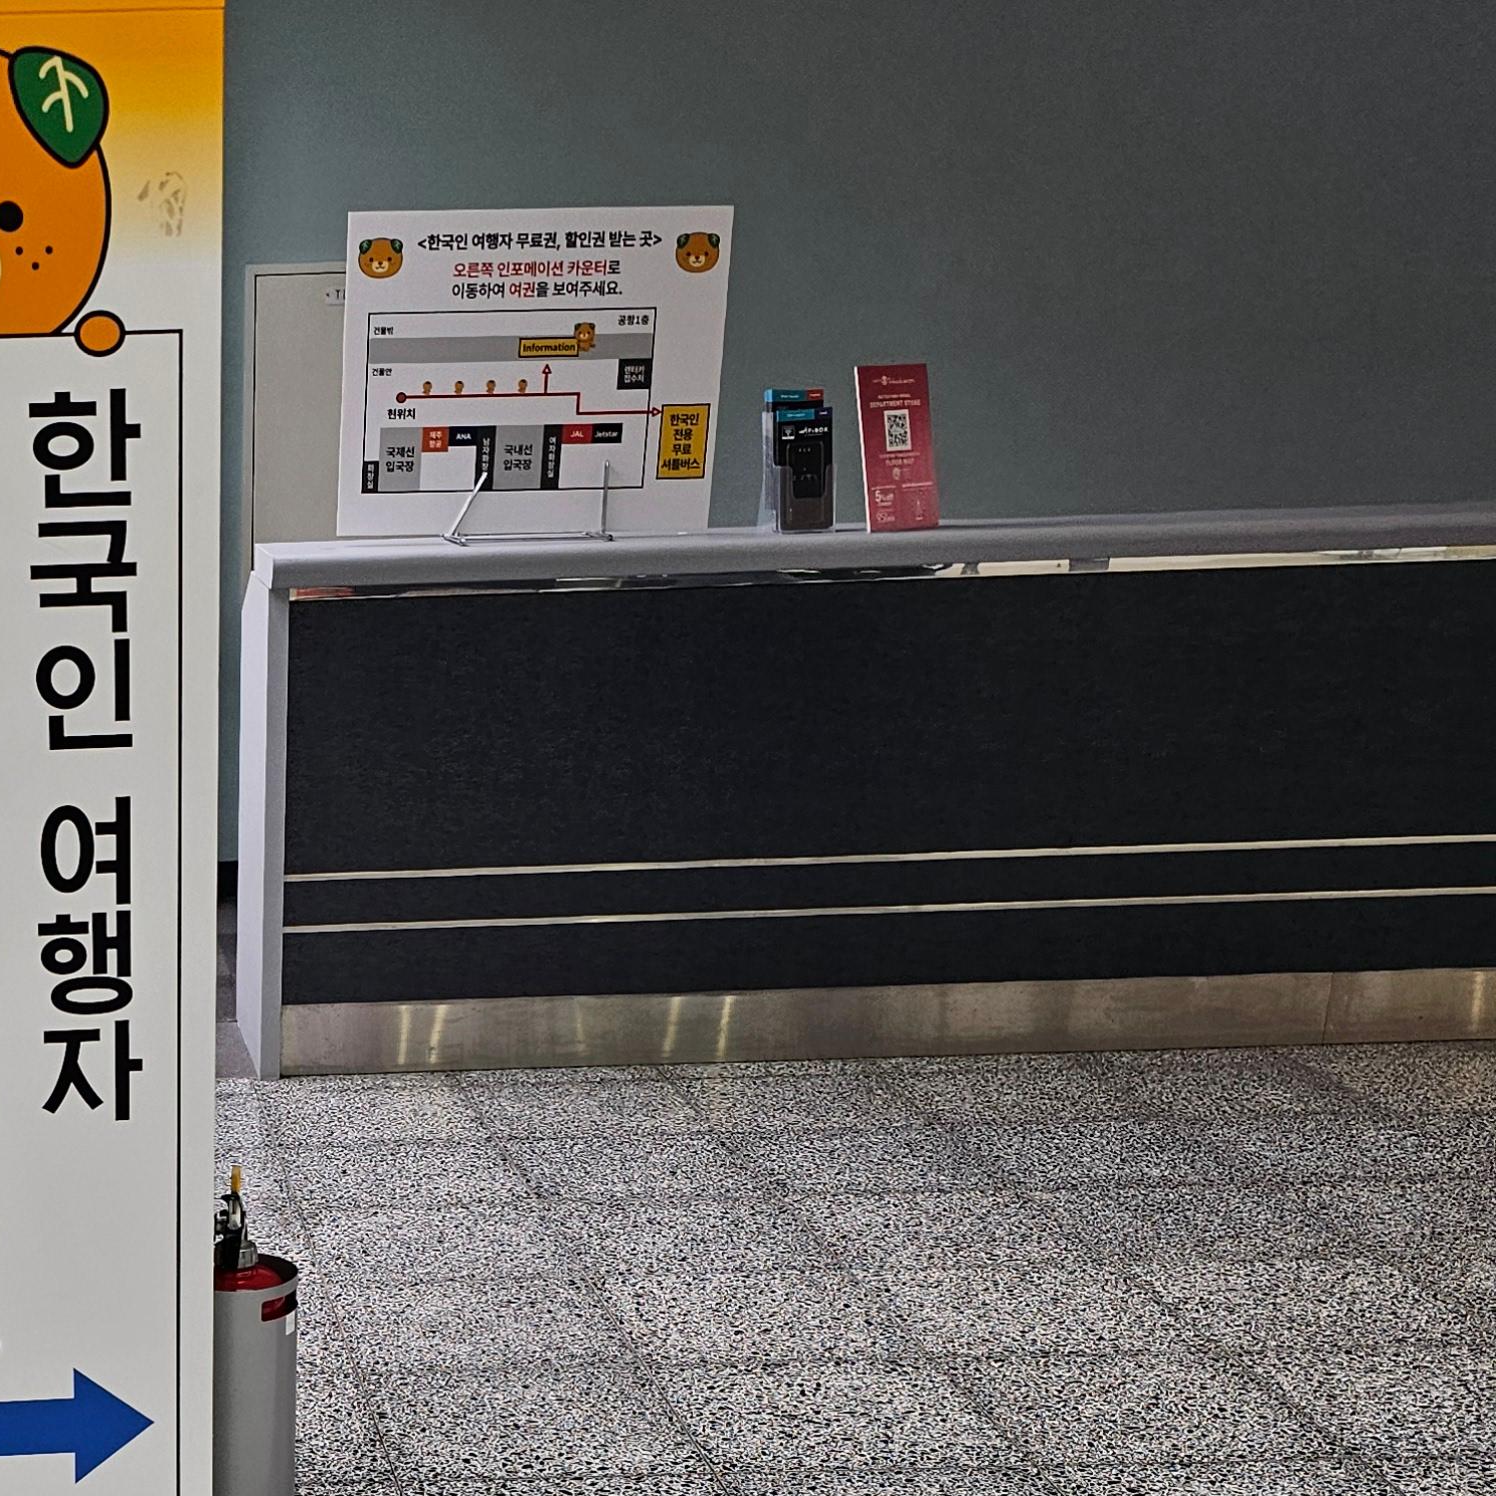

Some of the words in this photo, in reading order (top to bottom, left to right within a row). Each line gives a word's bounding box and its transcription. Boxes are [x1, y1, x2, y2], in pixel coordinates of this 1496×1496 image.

[418, 233, 468, 251] <한국인
[471, 232, 513, 250] 여행자
[516, 231, 560, 252] 무료권,
[565, 231, 605, 249] 할인권
[609, 230, 636, 248] 받는
[639, 230, 662, 248] 곳>
[453, 262, 494, 278] 오른쪽
[497, 260, 563, 277] 인포메이션
[567, 260, 621, 276] 카운터로
[451, 282, 505, 299] 이동하여
[509, 281, 549, 298] 여권을
[552, 280, 623, 297] 보여주세요.
[522, 341, 576, 353] Information
[387, 408, 416, 420] 현위치
[669, 413, 700, 426] 한국인
[455, 432, 472, 440] ANA
[570, 430, 584, 438] JAL
[672, 428, 693, 441] 전용
[385, 446, 415, 458] 국제선
[503, 444, 533, 456] 국내선
[672, 443, 692, 455] 무료
[385, 460, 414, 473] 입국장
[503, 458, 532, 471] 입국장
[27, 387, 142, 751] 한국인
[37, 794, 144, 1122] 여행자
